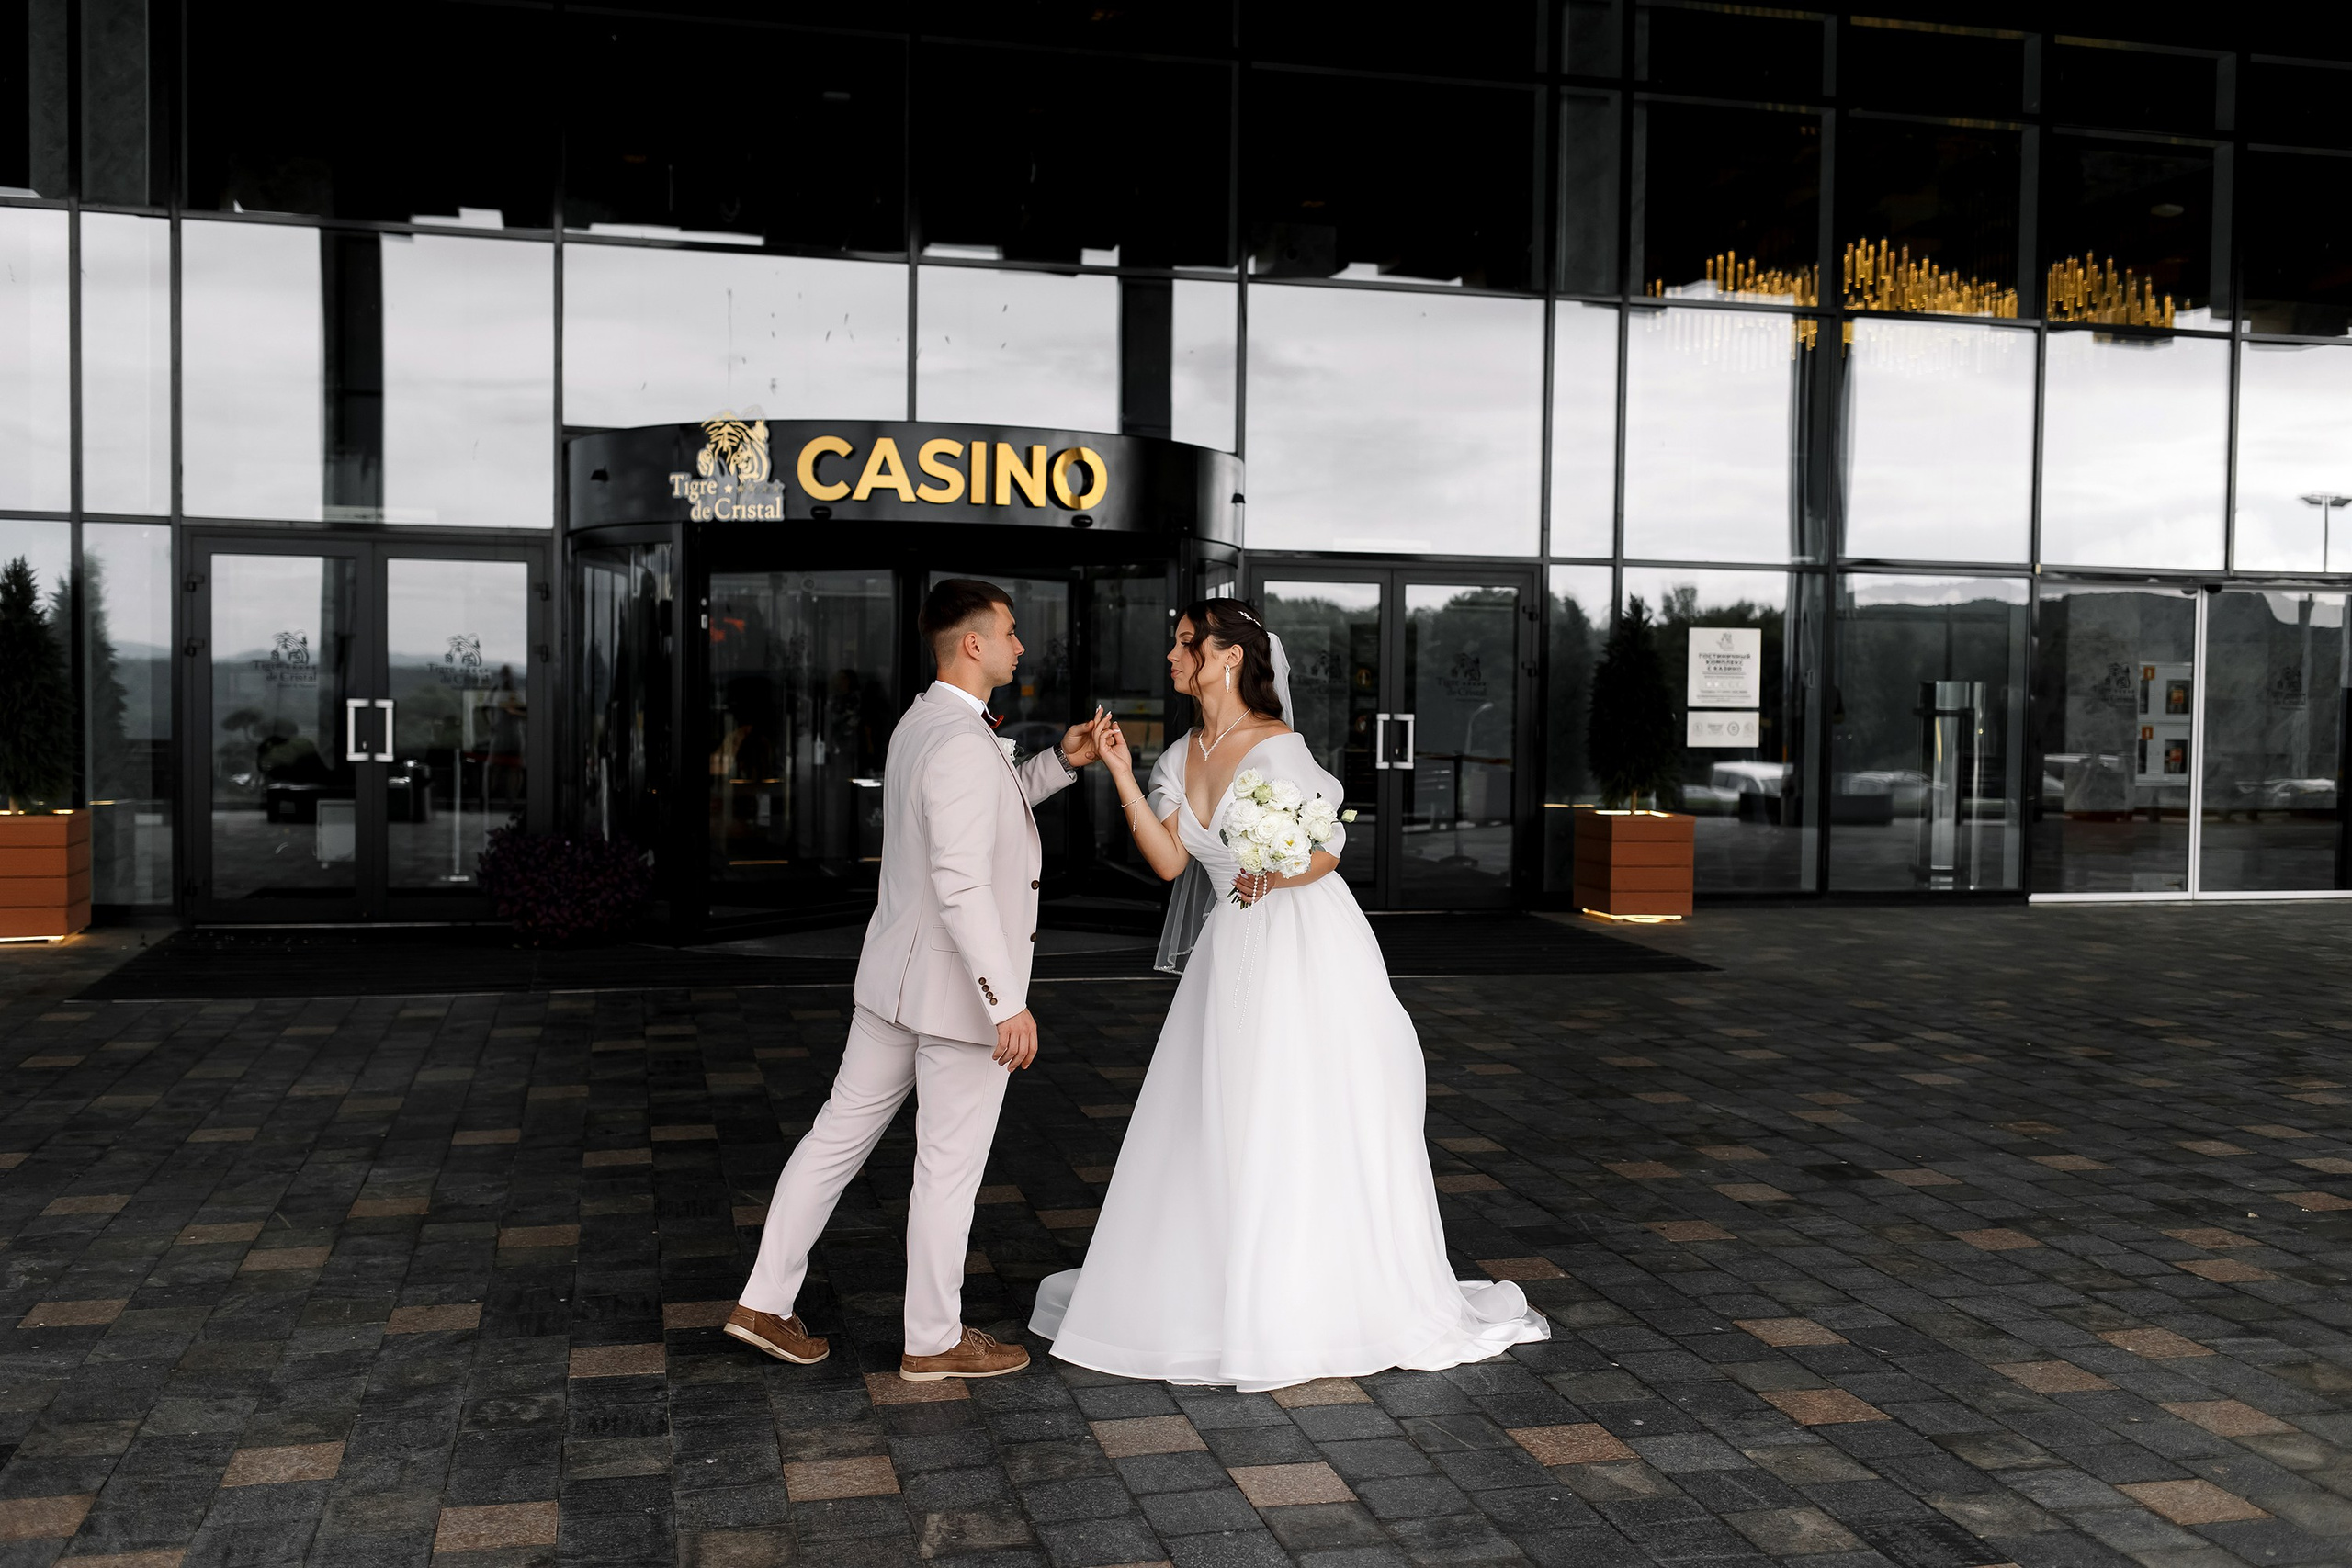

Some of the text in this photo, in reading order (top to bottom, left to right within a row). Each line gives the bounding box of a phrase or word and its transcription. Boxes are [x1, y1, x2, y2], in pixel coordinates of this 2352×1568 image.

[797, 435, 1108, 511] CASINO
[670, 474, 718, 503] Tigre
[690, 496, 782, 521] de Cristal
